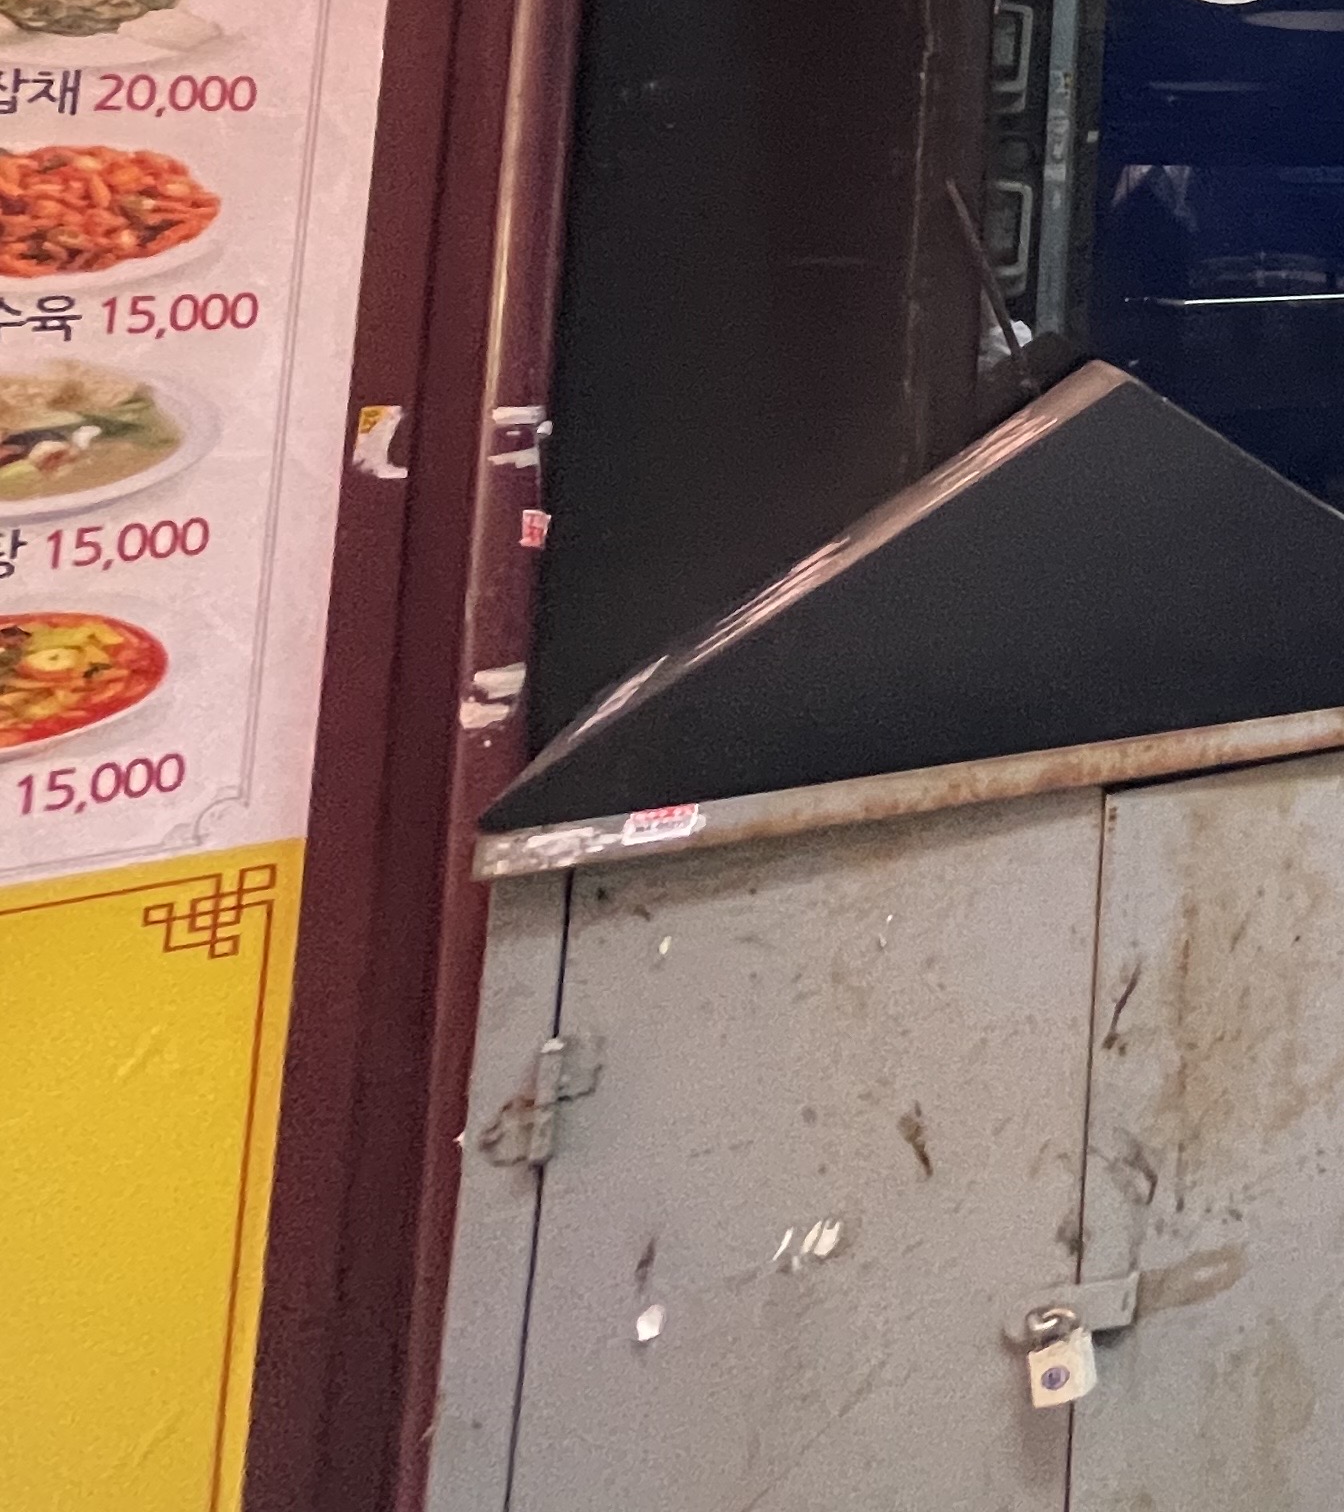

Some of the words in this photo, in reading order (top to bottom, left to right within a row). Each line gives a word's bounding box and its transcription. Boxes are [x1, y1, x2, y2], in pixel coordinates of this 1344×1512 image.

[94, 73, 257, 117] 20,000
[102, 292, 259, 339] 15,000
[46, 516, 210, 571] 15,000
[18, 752, 186, 816] 15,000
